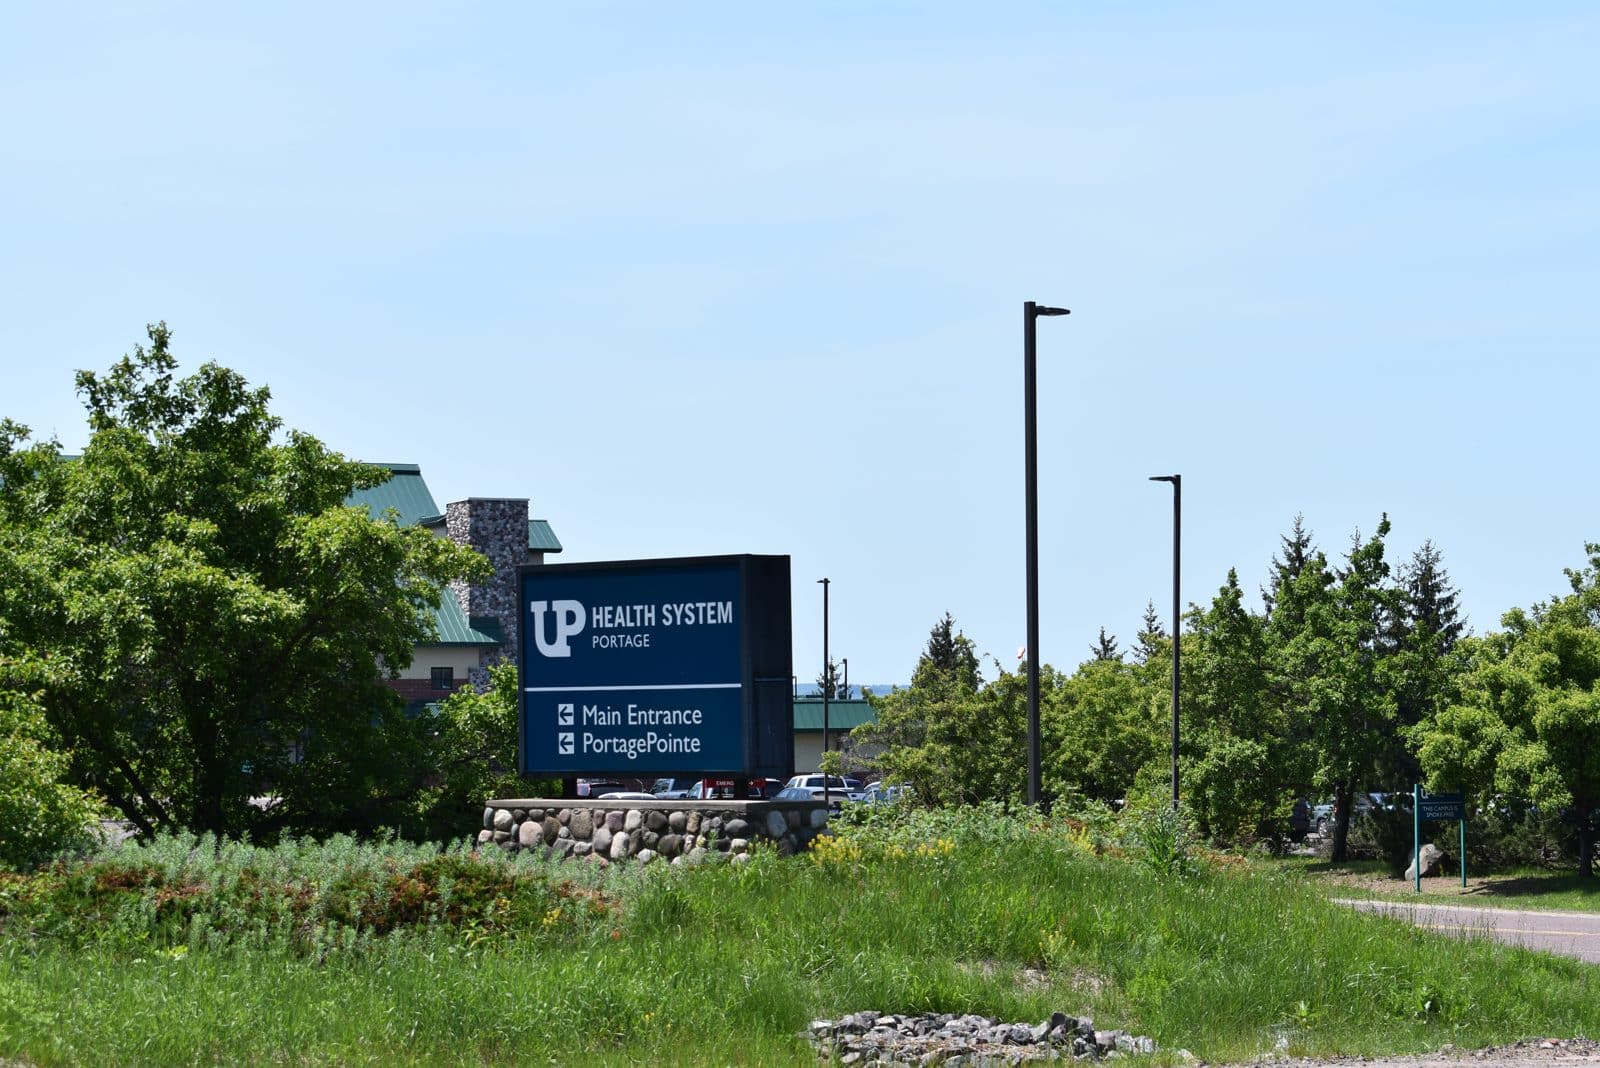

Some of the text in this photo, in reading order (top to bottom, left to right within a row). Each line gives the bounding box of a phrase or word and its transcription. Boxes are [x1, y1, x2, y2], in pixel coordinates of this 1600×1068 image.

[530, 599, 587, 658] UP
[592, 600, 733, 629] HEALTH SYSTEM
[592, 633, 651, 649] PORTAGE
[582, 703, 703, 726] Main Entrance
[582, 731, 701, 759] PortagePointe
